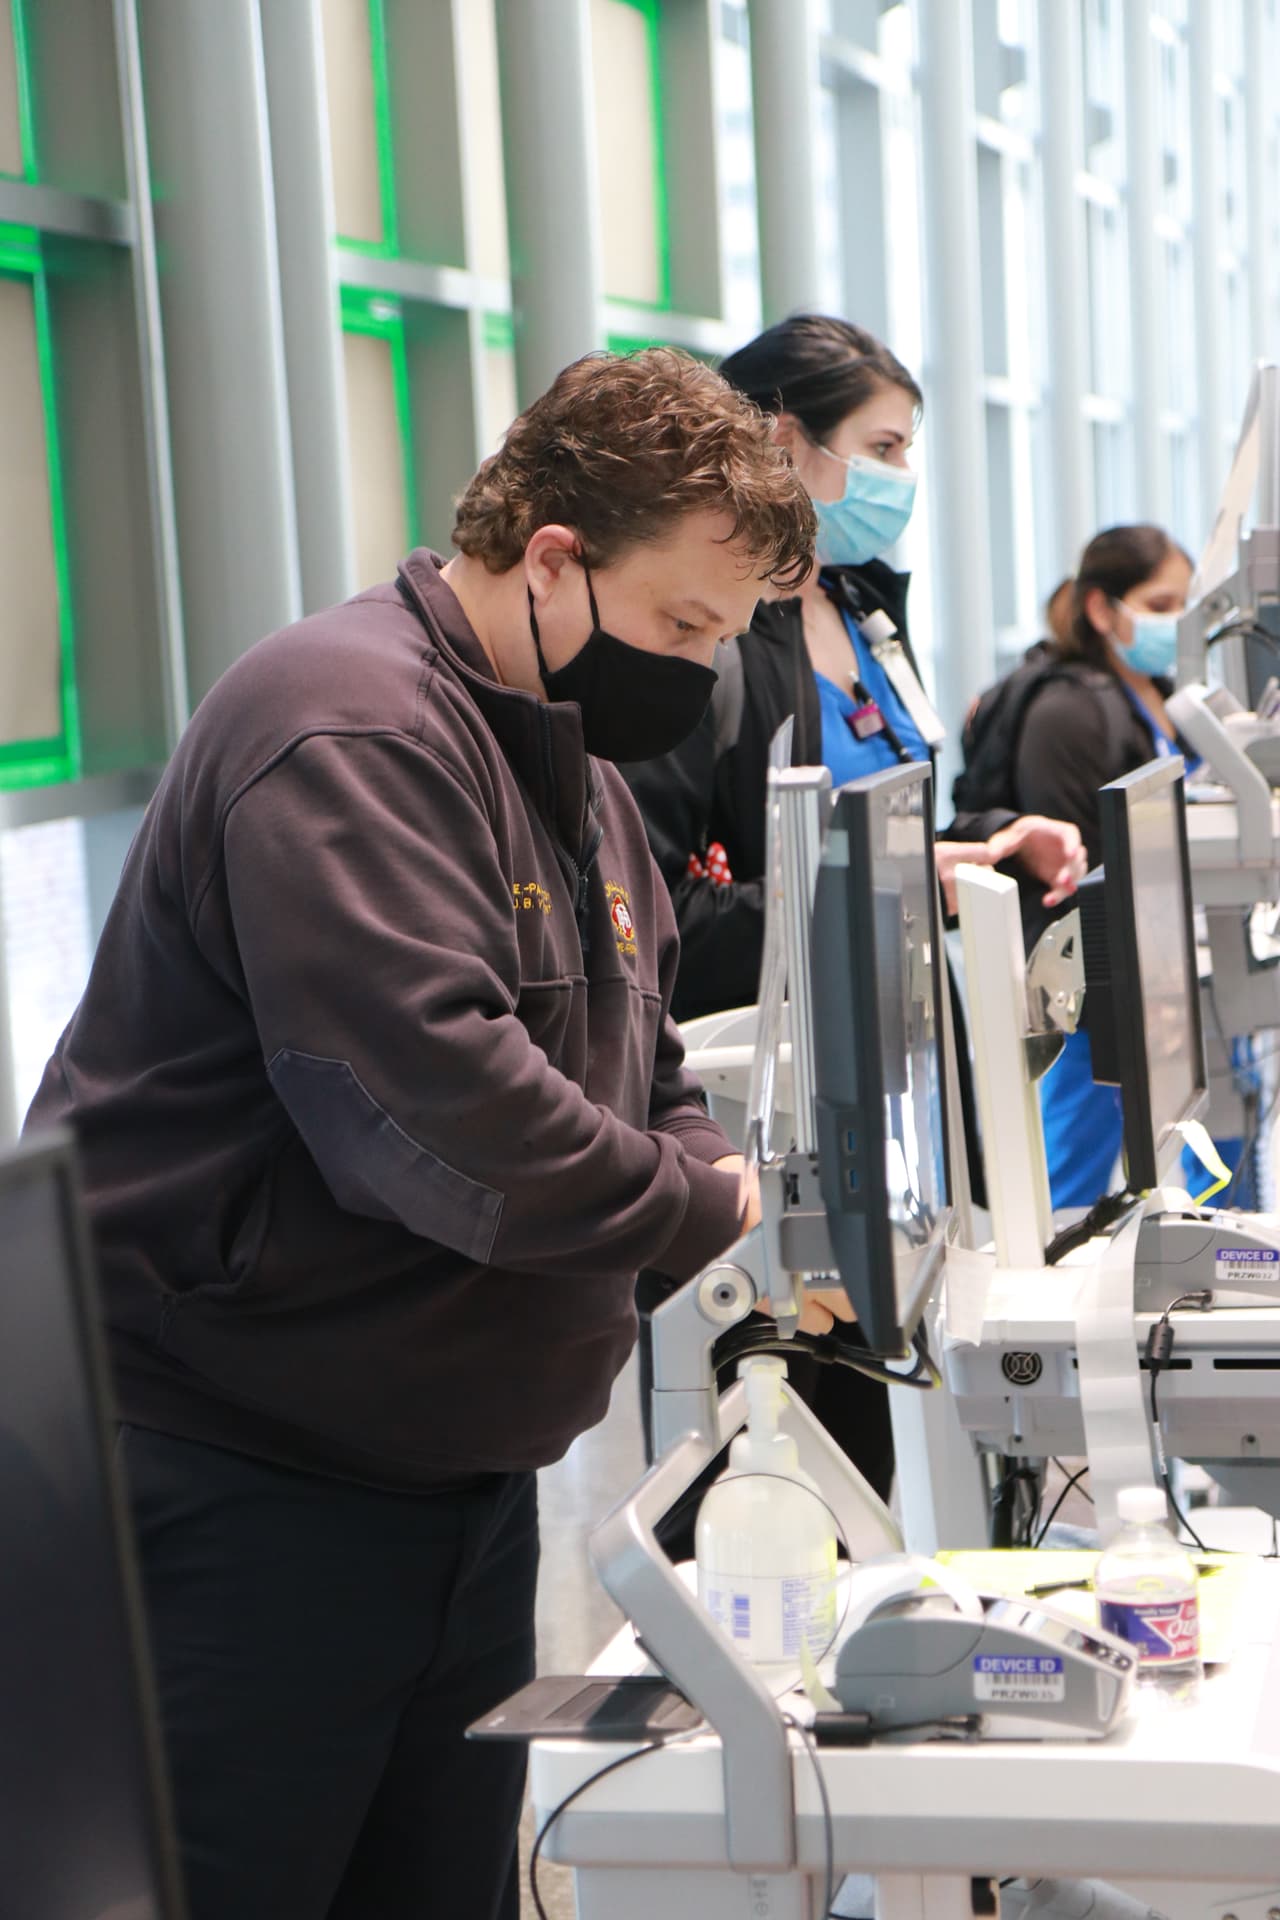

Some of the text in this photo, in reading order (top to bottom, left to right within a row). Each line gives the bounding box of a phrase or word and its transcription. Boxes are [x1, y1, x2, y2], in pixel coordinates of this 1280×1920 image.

[1220, 1250, 1274, 1261] DEVICE ID
[980, 1658, 1057, 1673] DEVICE ID
